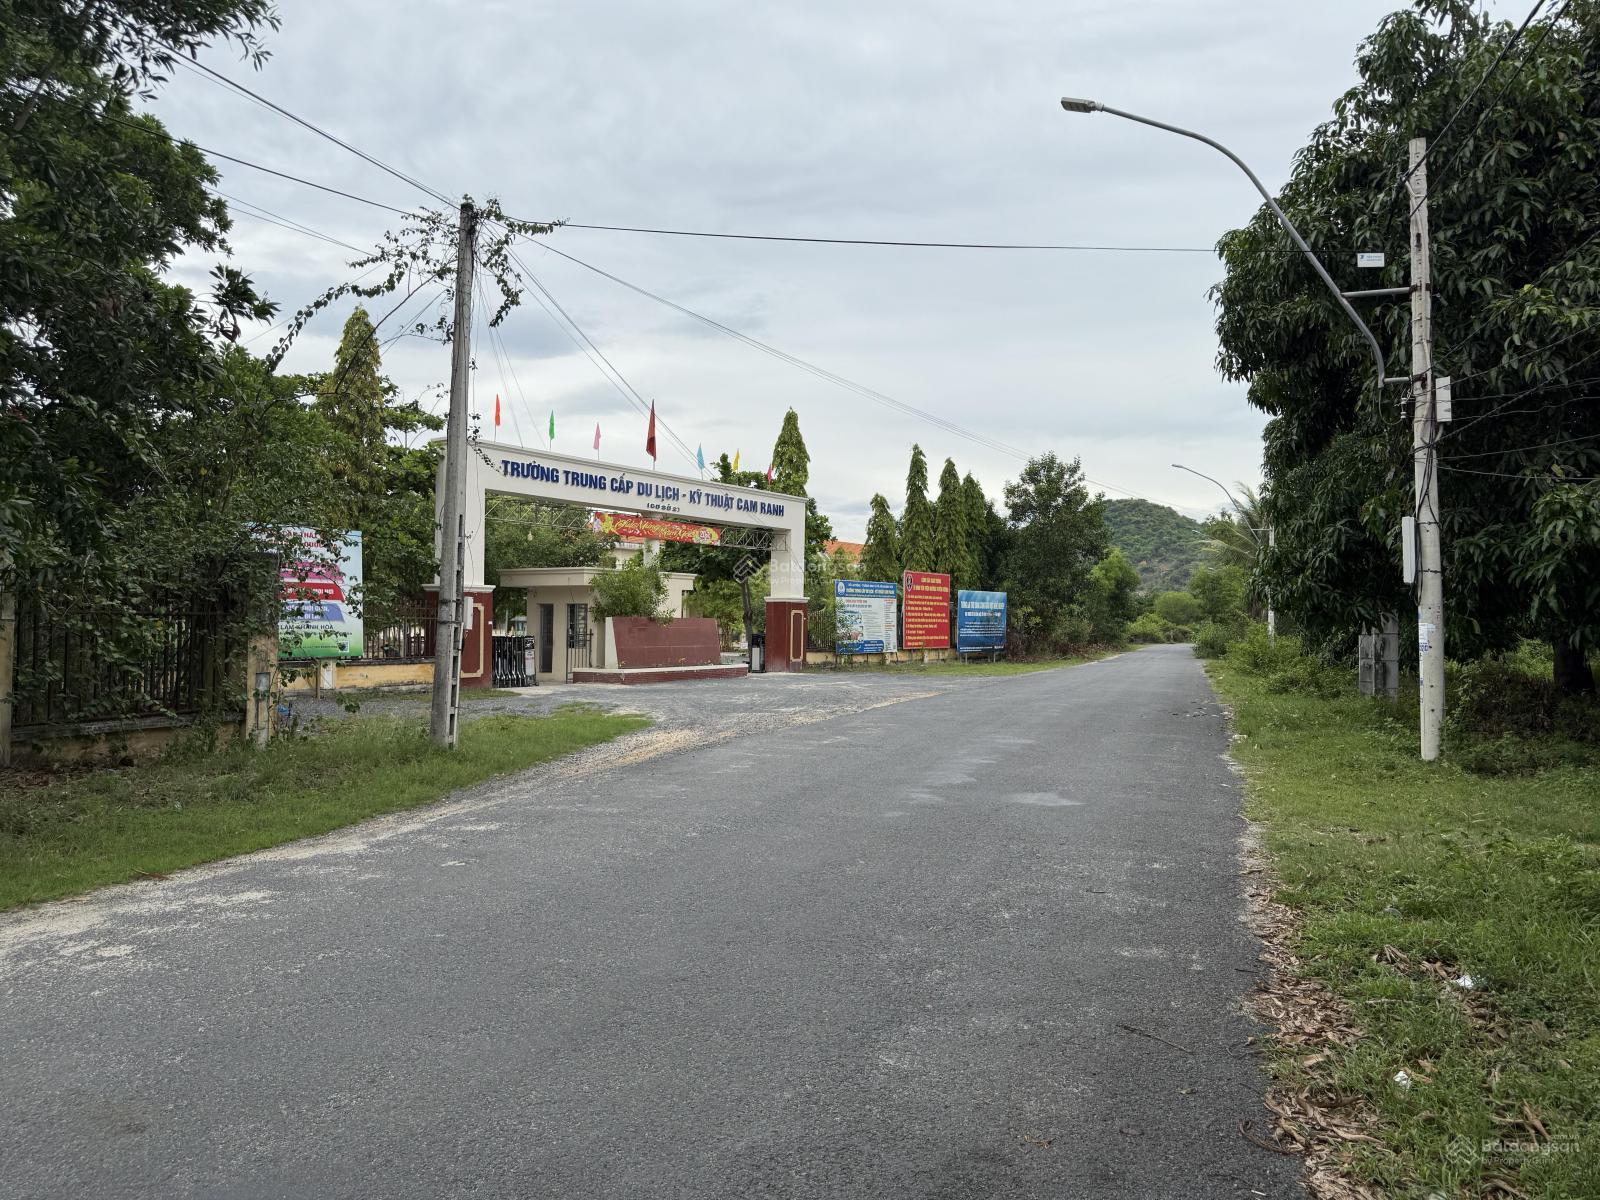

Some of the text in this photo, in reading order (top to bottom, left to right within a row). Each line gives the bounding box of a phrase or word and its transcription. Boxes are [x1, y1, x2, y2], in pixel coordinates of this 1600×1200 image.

[501, 460, 560, 484] TRƯỜNG
[563, 469, 607, 491] TRUNG
[610, 473, 634, 494] CẤP
[637, 482, 653, 497] DU
[655, 484, 680, 503] LỊCH
[688, 488, 703, 505] KỸ
[704, 493, 735, 512] THUẬT
[736, 498, 758, 513] CAM
[760, 502, 785, 517] RANH
